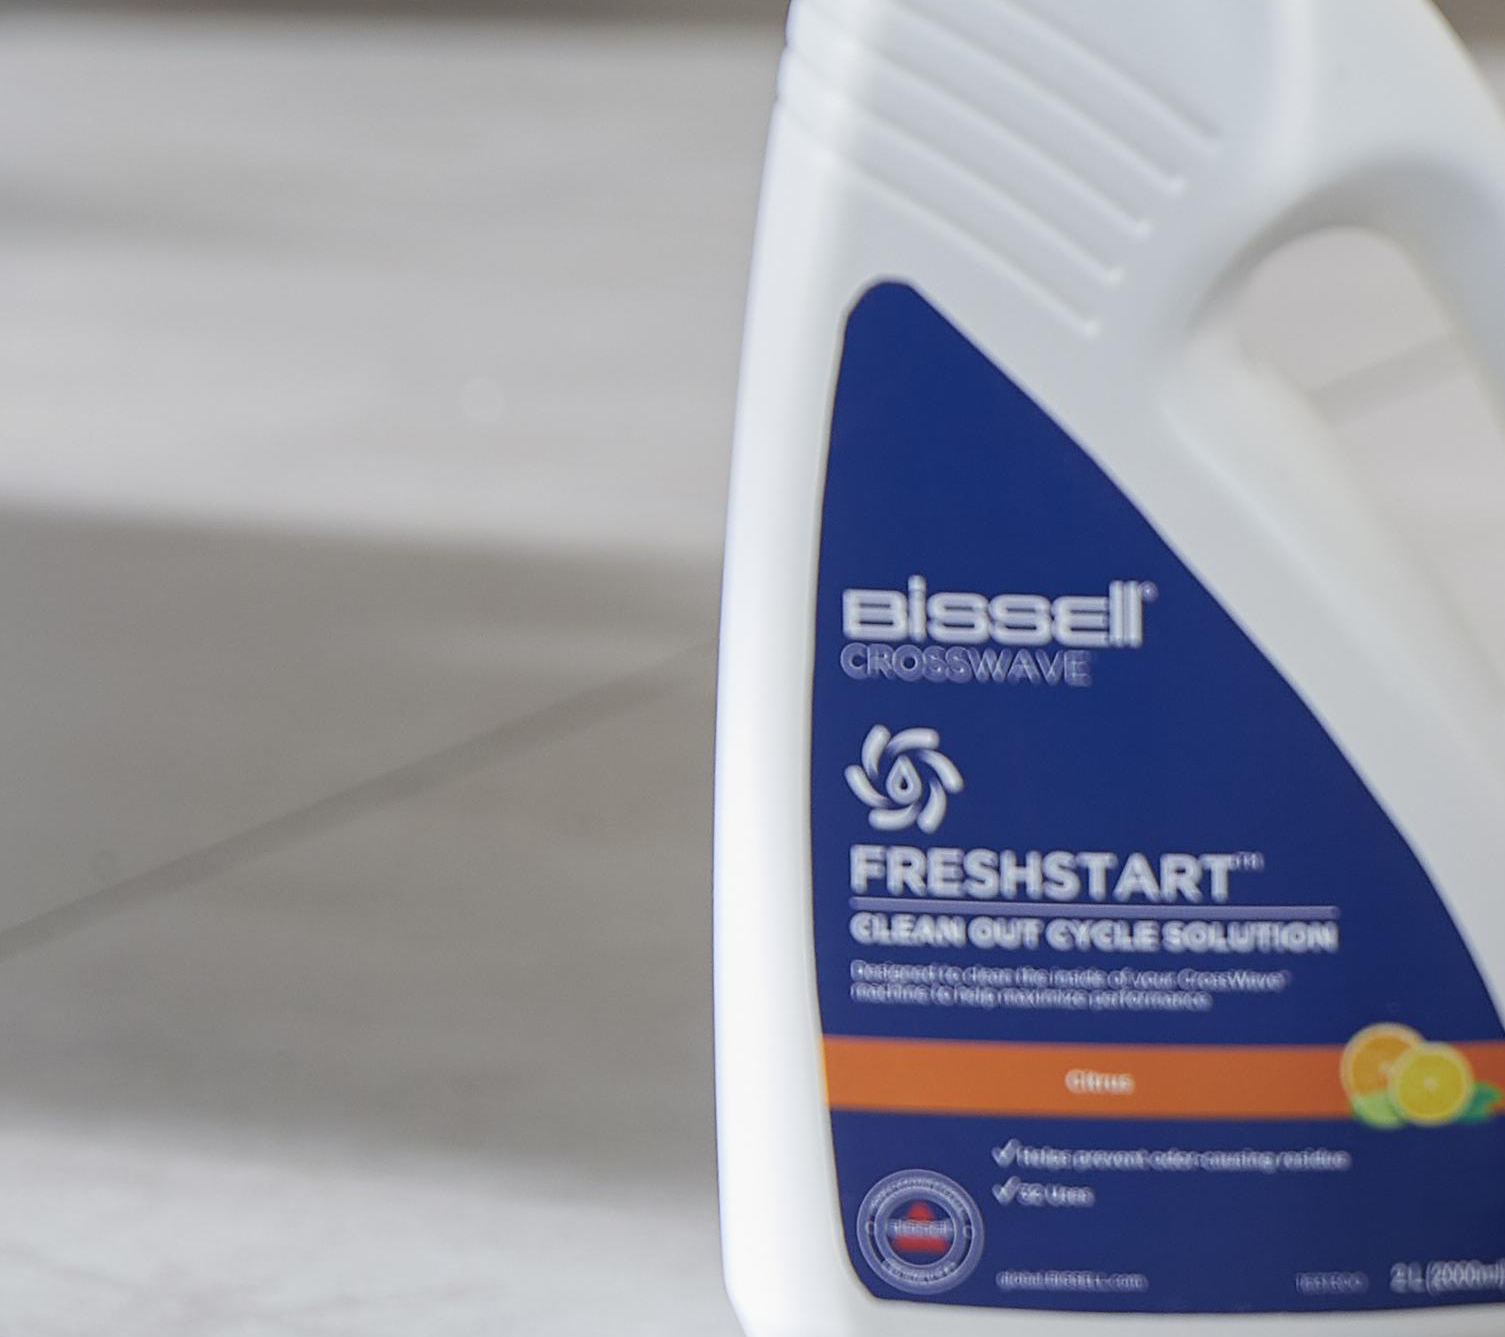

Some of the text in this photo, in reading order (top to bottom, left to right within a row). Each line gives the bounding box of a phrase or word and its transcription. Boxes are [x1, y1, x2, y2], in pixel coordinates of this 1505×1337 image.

[840, 642, 1094, 687] CROSSWAVE
[849, 911, 1339, 954] CLEAN OUT CYCLE SOLUTION
[850, 960, 940, 984] Designed
[965, 964, 1016, 987] clean
[1017, 966, 1050, 987] the
[1051, 966, 1107, 989] inside
[1132, 969, 1177, 993] your
[850, 981, 929, 1004] machine
[955, 984, 1000, 1008] help
[1000, 986, 1089, 1008] maximize
[1090, 988, 1212, 1012] performance
[1065, 1068, 1136, 1095] Citrus
[1016, 1147, 1074, 1170] Helps
[1074, 1149, 1149, 1171] prevent
[1277, 1148, 1351, 1172] residue
